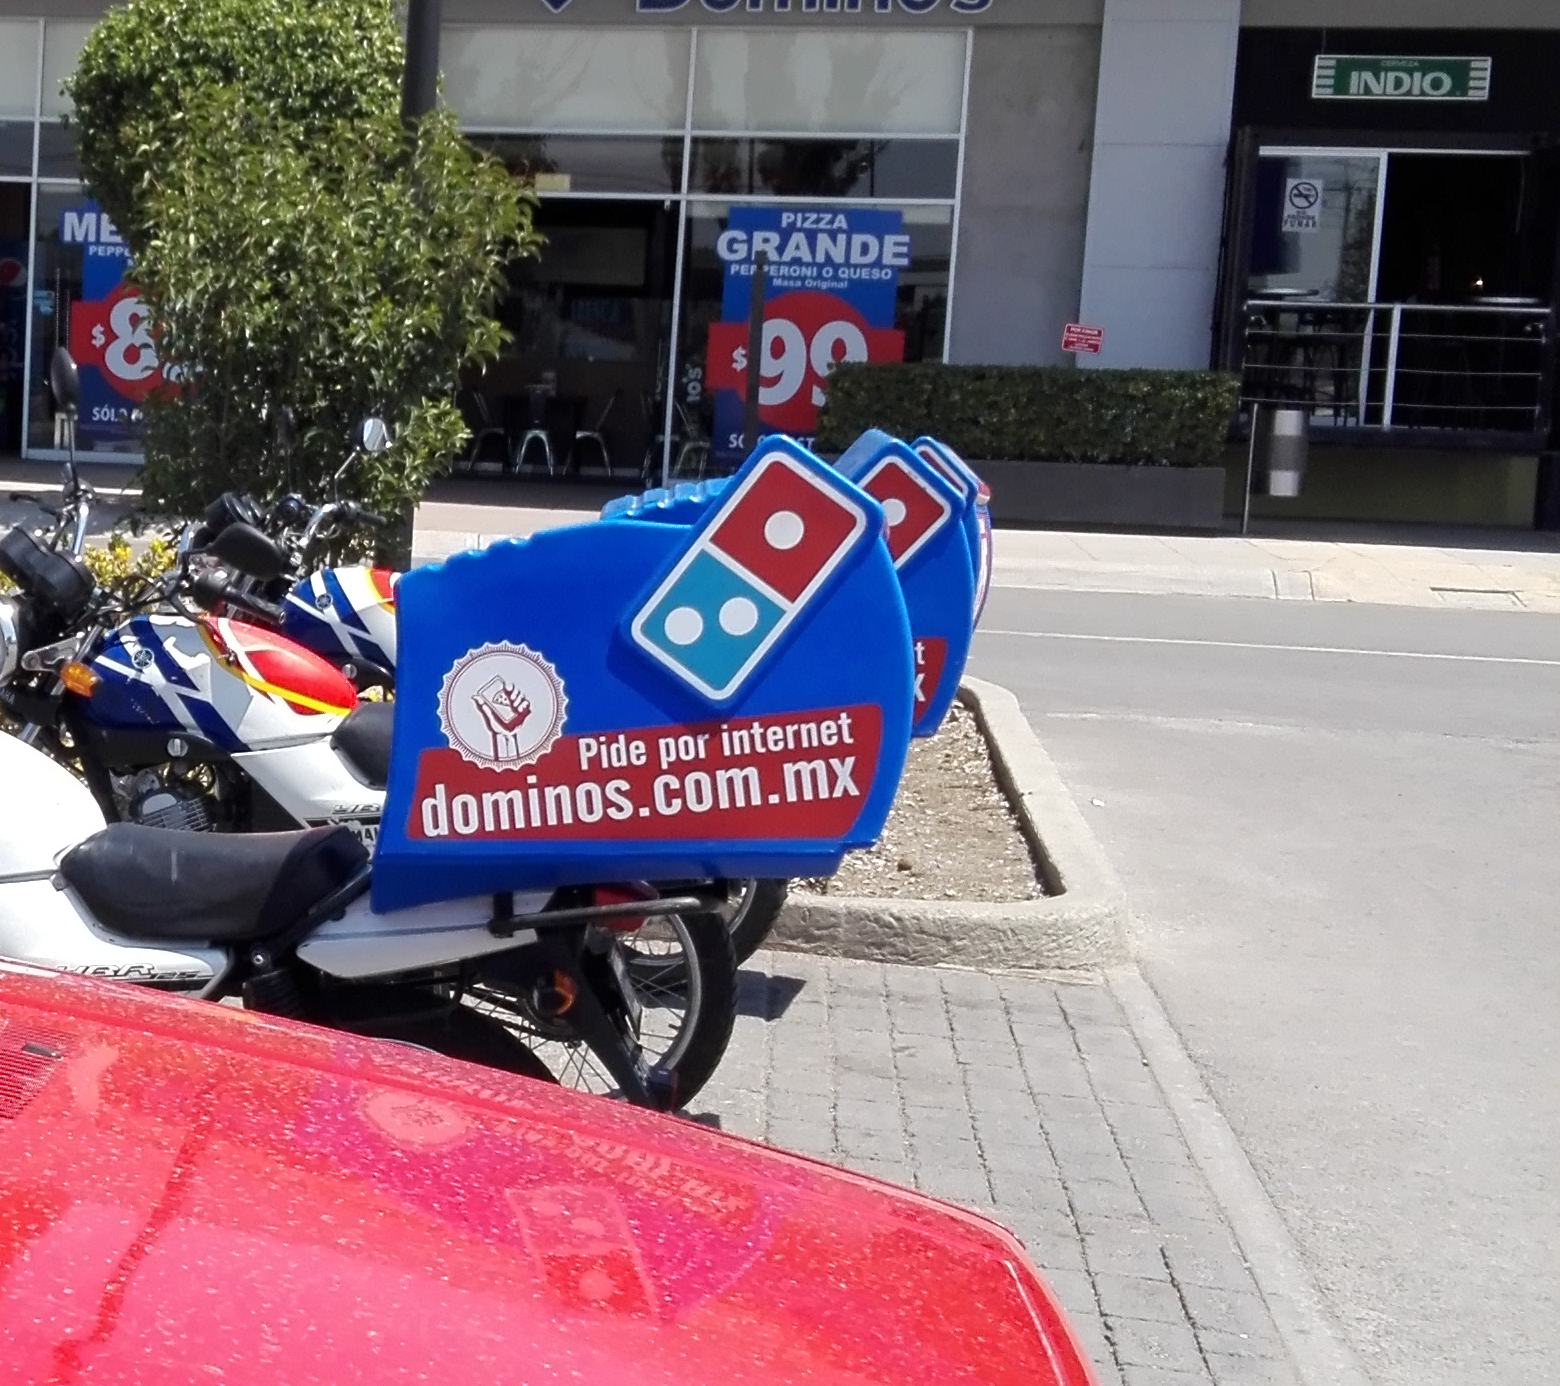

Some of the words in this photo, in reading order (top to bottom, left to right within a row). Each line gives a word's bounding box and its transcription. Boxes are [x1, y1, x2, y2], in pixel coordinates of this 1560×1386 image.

[1349, 71, 1453, 96] INDIO
[781, 212, 849, 230] PIZZA
[716, 229, 911, 267] GRANDE
[822, 267, 833, 278] O
[838, 268, 892, 280] QUESO
[579, 734, 647, 771] Pide
[658, 731, 710, 767] por
[721, 713, 854, 755] internet
[420, 755, 860, 838] dominos.com.mx
